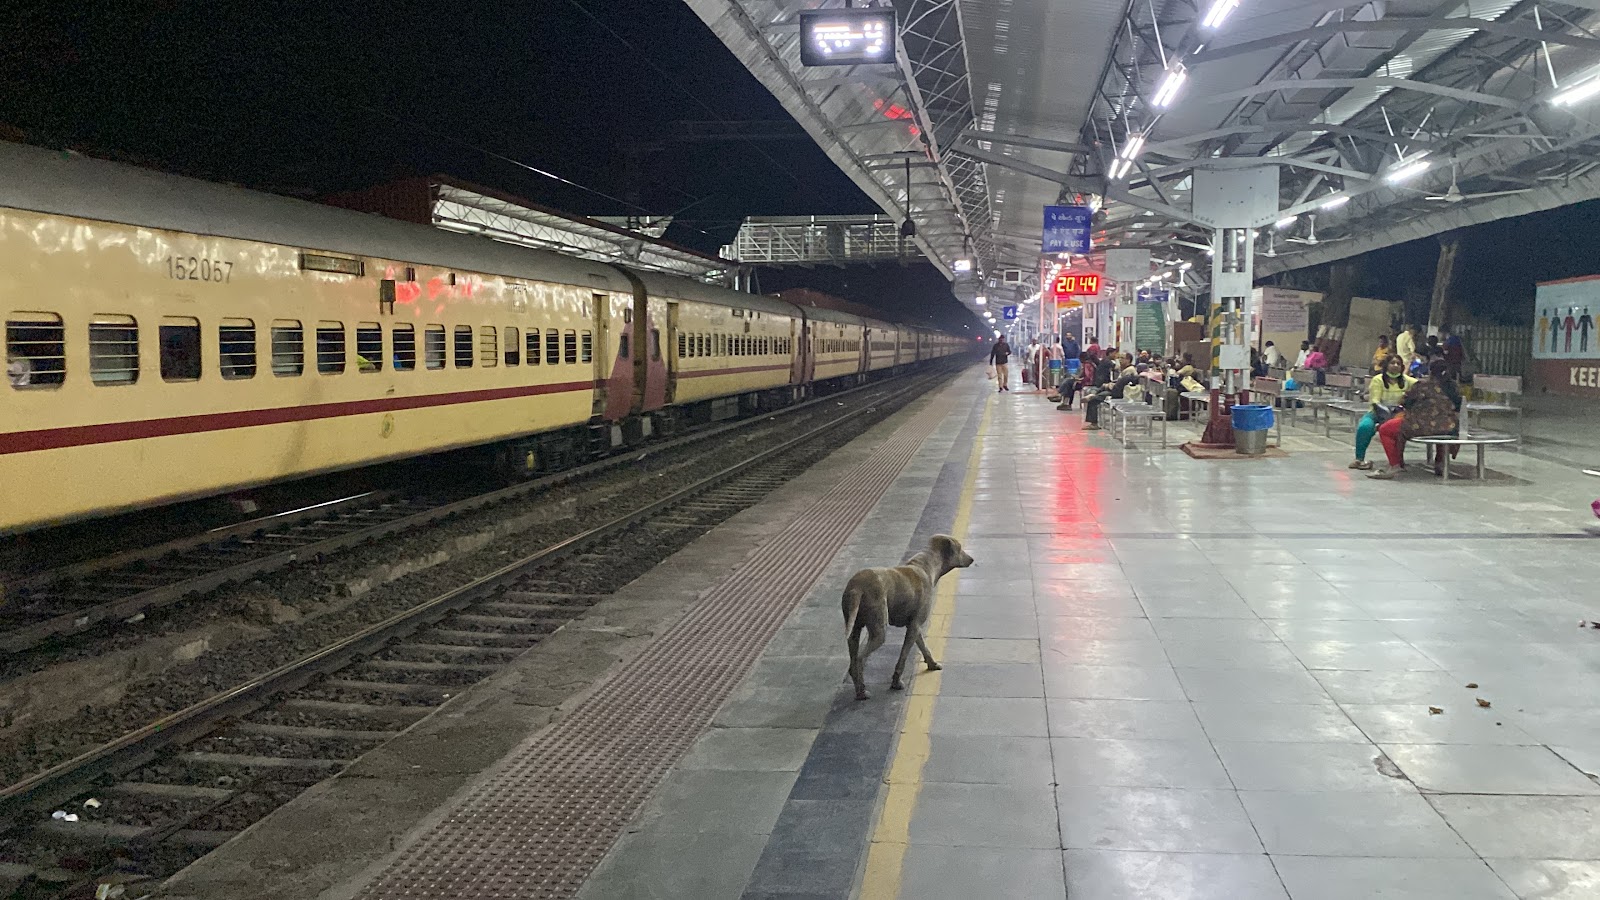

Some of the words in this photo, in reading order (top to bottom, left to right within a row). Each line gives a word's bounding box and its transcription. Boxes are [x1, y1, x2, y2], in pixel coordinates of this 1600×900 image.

[1071, 240, 1084, 248] USE
[166, 256, 233, 283] 152057
[1006, 308, 1014, 318] 4
[1570, 366, 1600, 388] KEE
